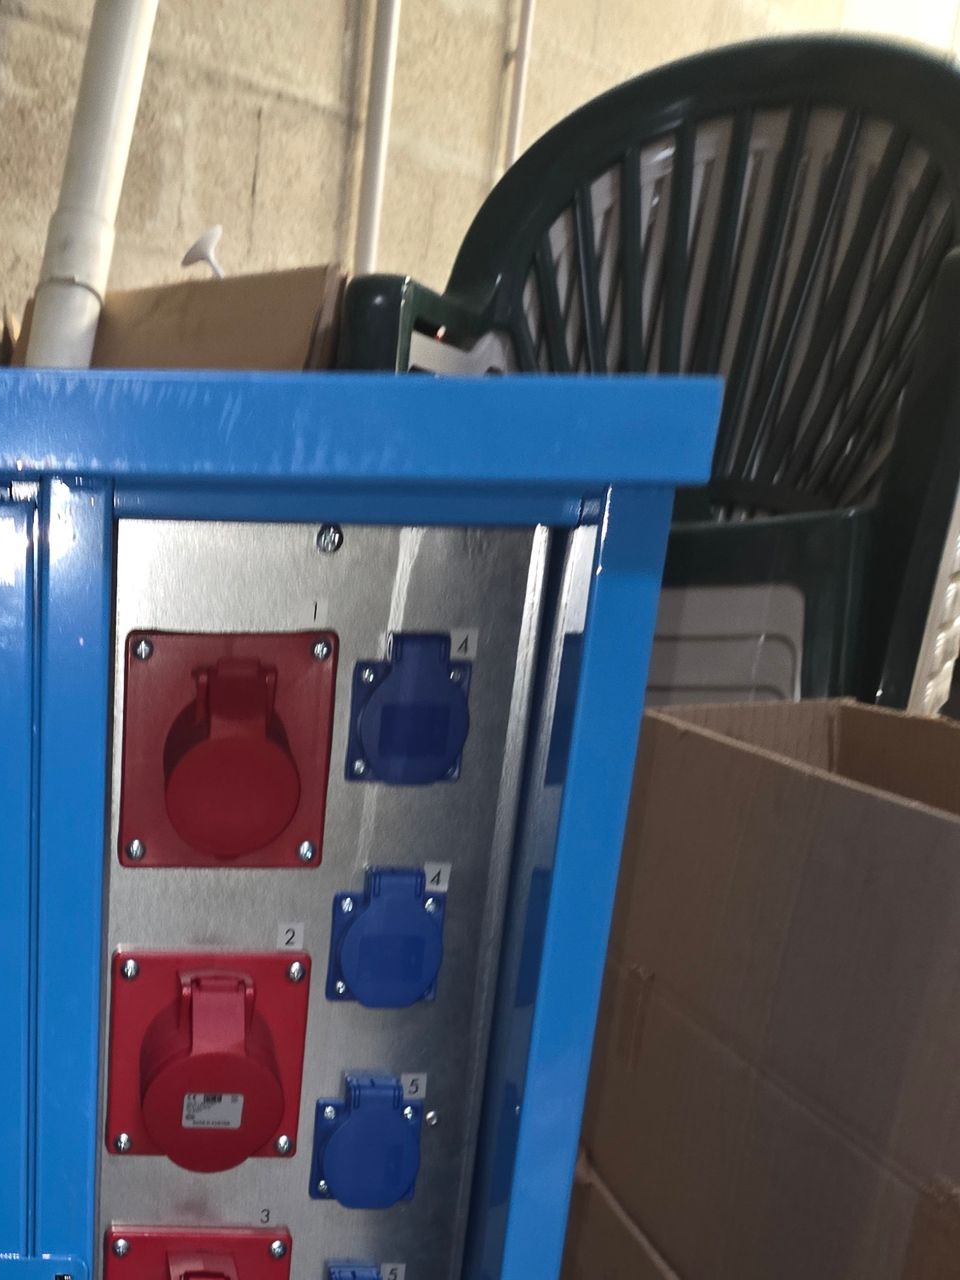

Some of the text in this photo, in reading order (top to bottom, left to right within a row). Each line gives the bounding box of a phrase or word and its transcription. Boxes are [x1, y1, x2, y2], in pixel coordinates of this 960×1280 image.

[284, 928, 296, 946] 2
[408, 1078, 420, 1095] 5
[260, 1208, 271, 1224] 3
